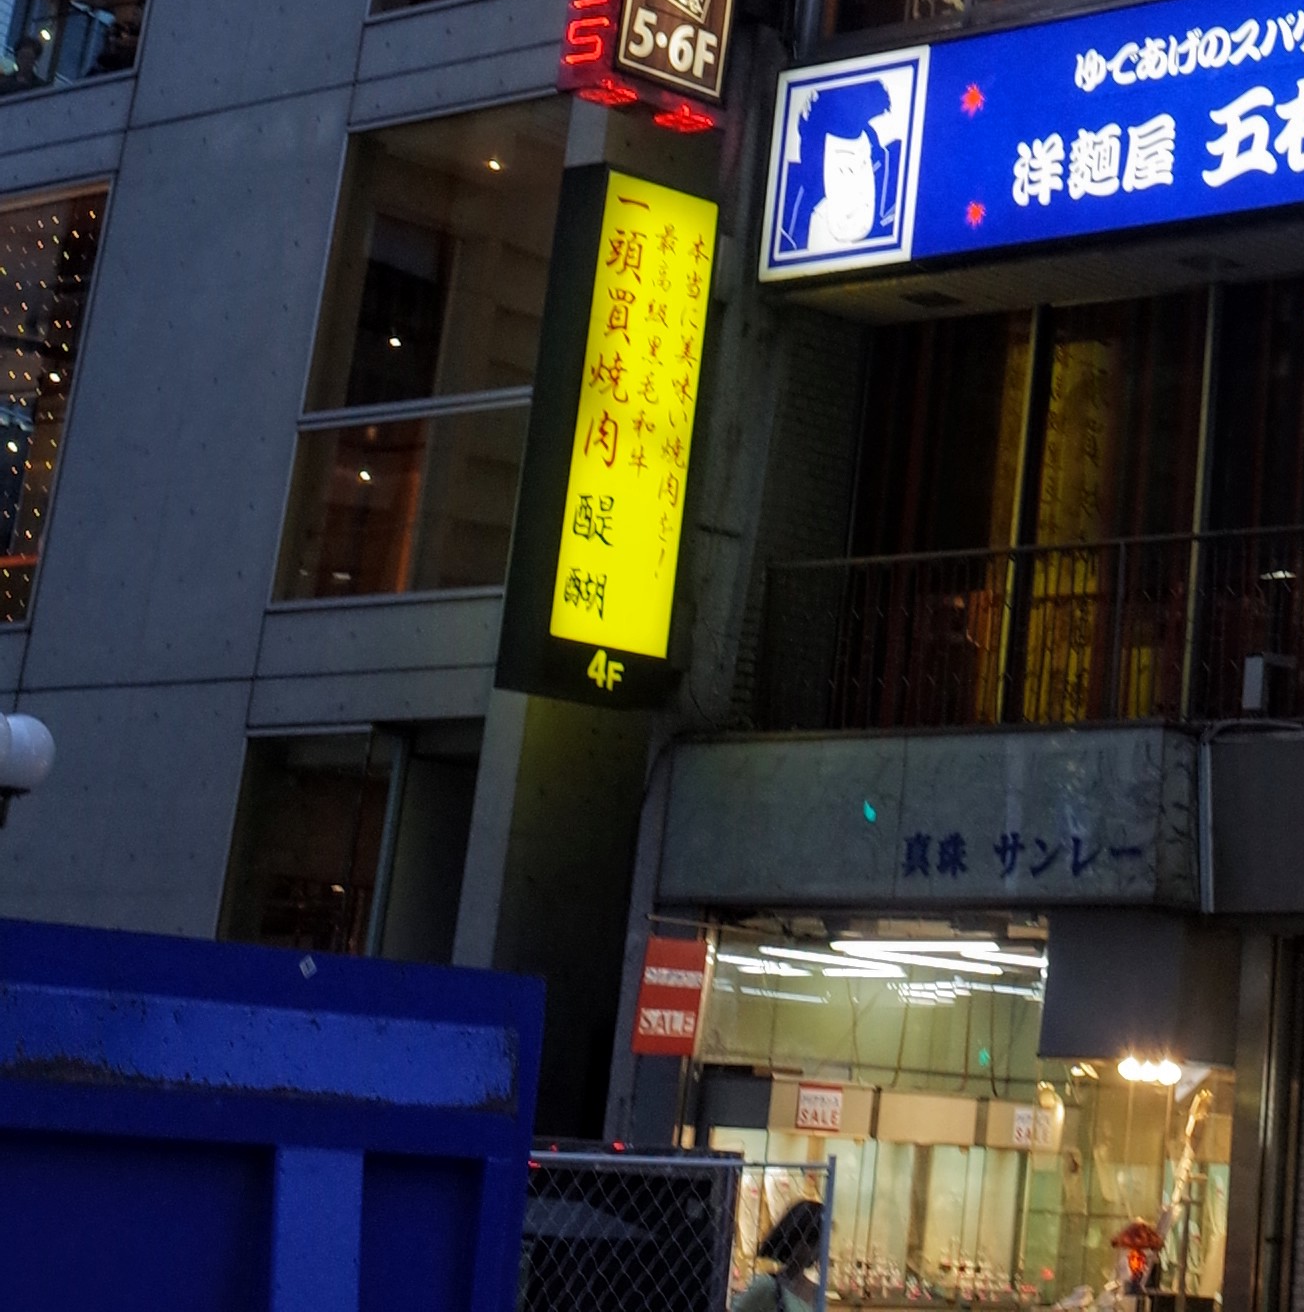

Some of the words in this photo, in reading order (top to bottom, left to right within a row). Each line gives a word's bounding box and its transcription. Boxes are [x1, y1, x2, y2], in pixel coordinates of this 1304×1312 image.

[586, 649, 625, 691] 4F
[995, 832, 1143, 876] サンレー
